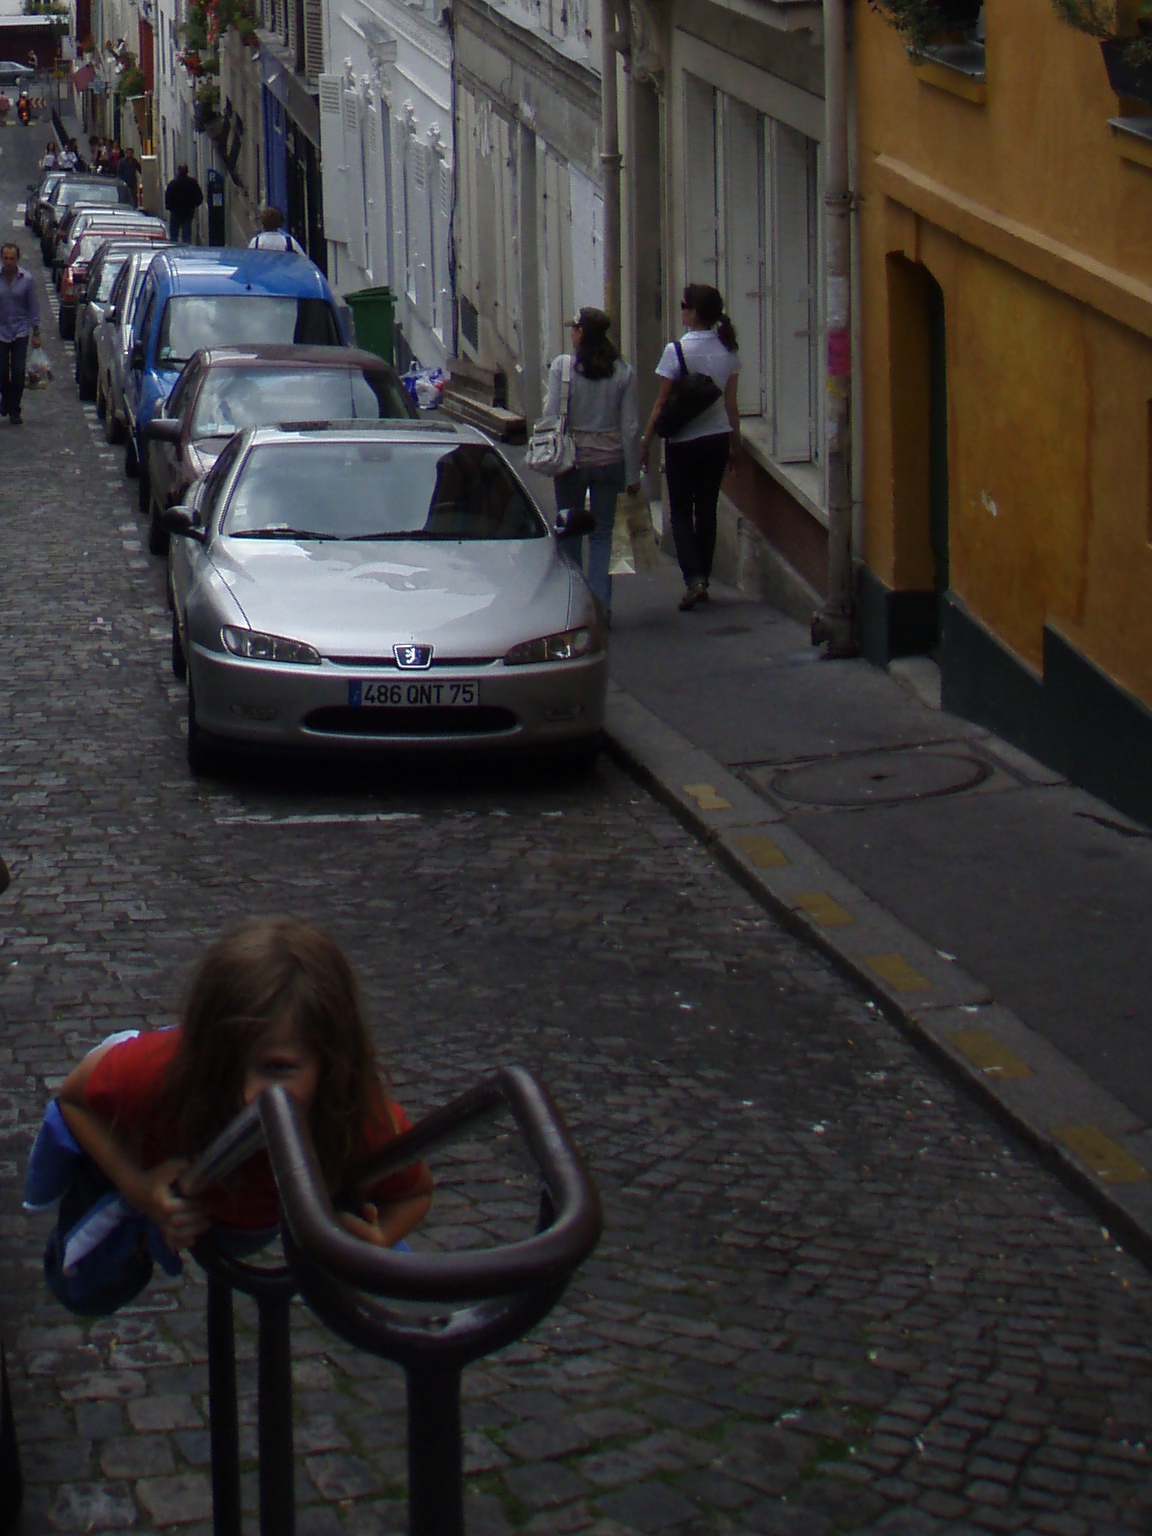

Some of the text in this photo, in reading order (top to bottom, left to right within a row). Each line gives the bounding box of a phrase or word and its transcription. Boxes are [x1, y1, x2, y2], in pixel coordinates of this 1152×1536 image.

[363, 684, 474, 704] 486 QNT 75
